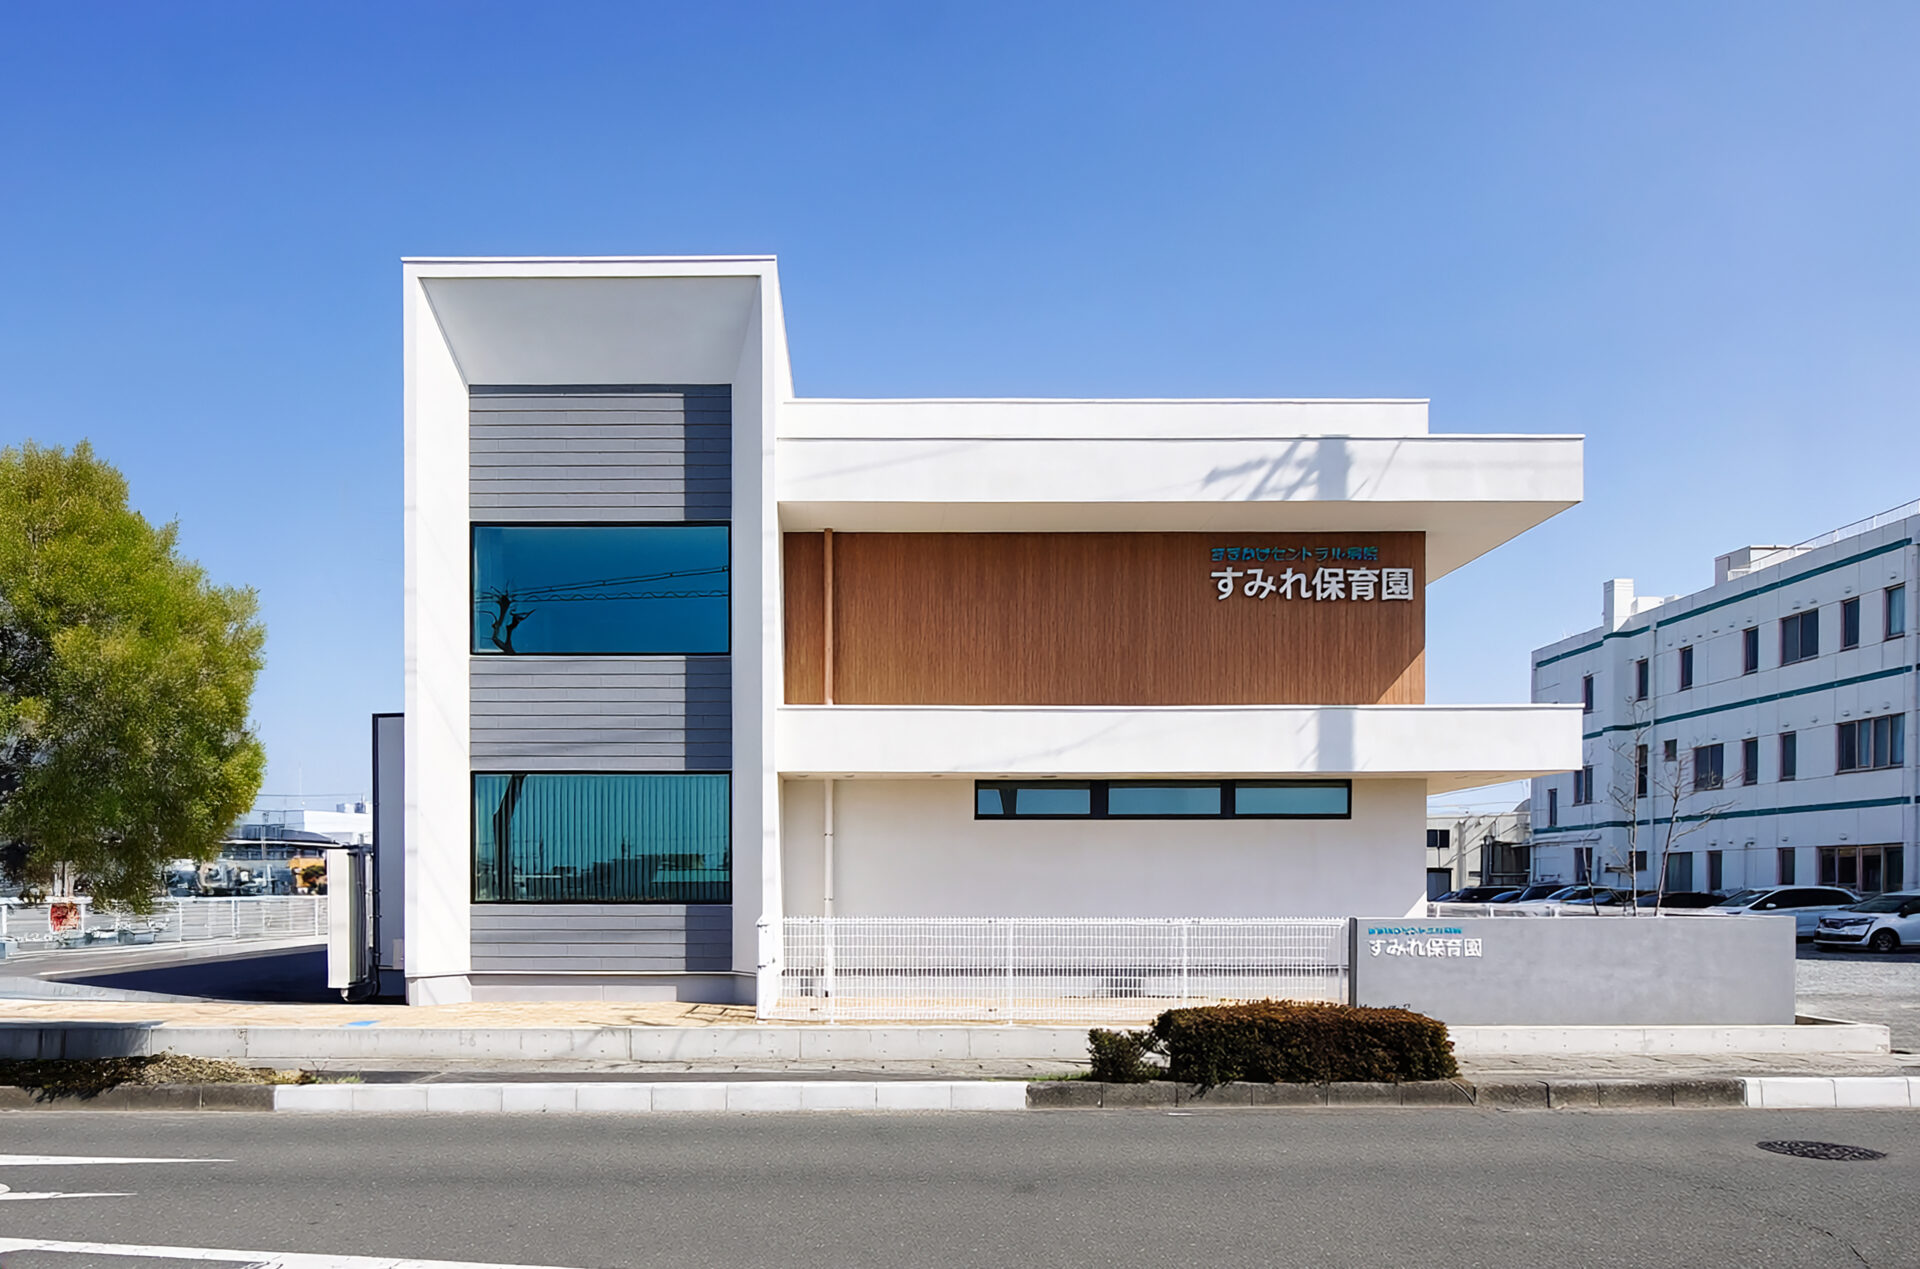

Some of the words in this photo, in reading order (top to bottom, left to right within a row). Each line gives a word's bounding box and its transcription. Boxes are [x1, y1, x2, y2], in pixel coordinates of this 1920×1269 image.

[1211, 567, 1414, 600] すみれ保育園
[1369, 938, 1482, 957] すみれ保育園
